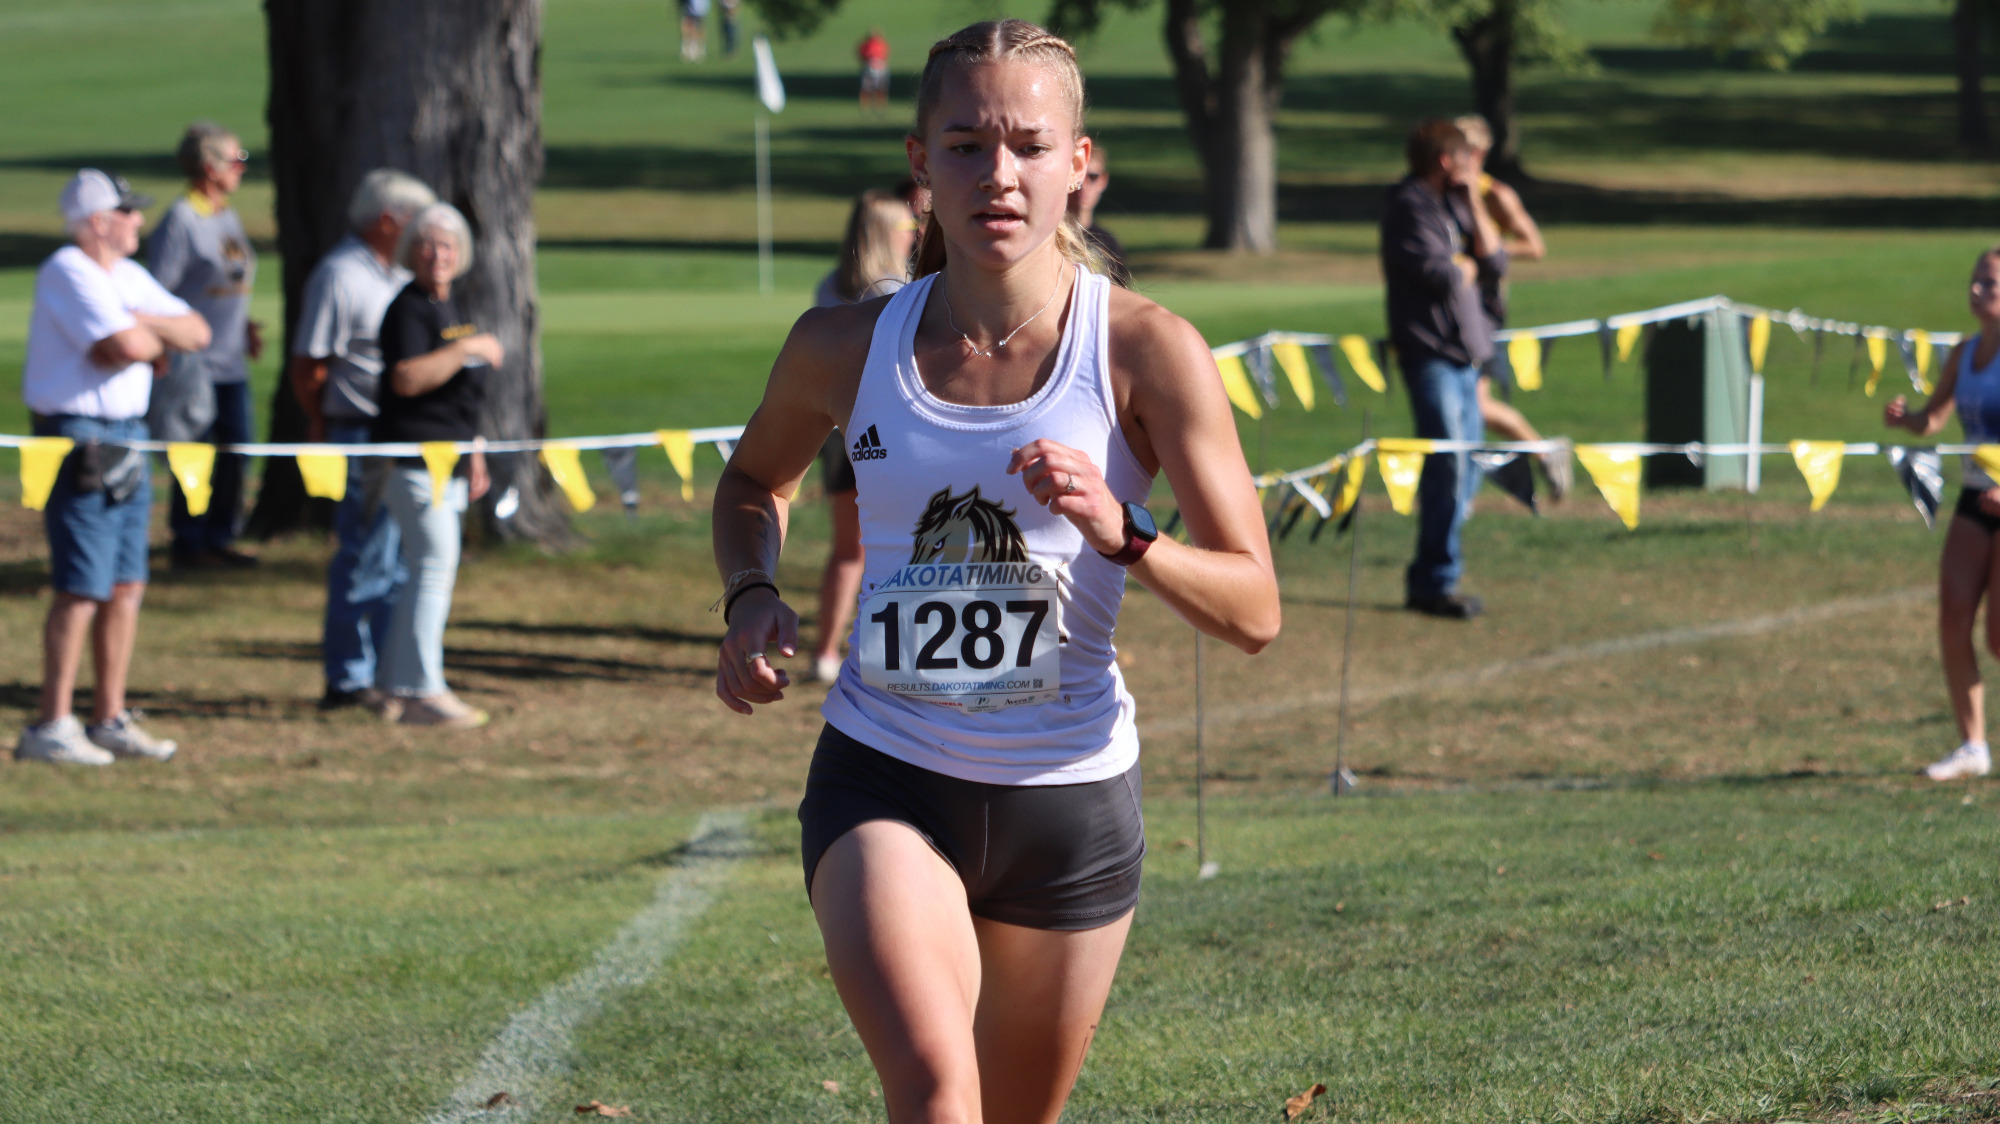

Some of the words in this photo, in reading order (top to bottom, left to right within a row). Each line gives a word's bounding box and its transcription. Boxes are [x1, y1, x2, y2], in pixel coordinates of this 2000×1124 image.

[852, 447, 887, 461] adidas
[880, 565, 1042, 589] AKOTATIMING
[871, 600, 1049, 670] 1287
[887, 680, 1031, 692] RESULTS.DAKOTATIMING.COM
